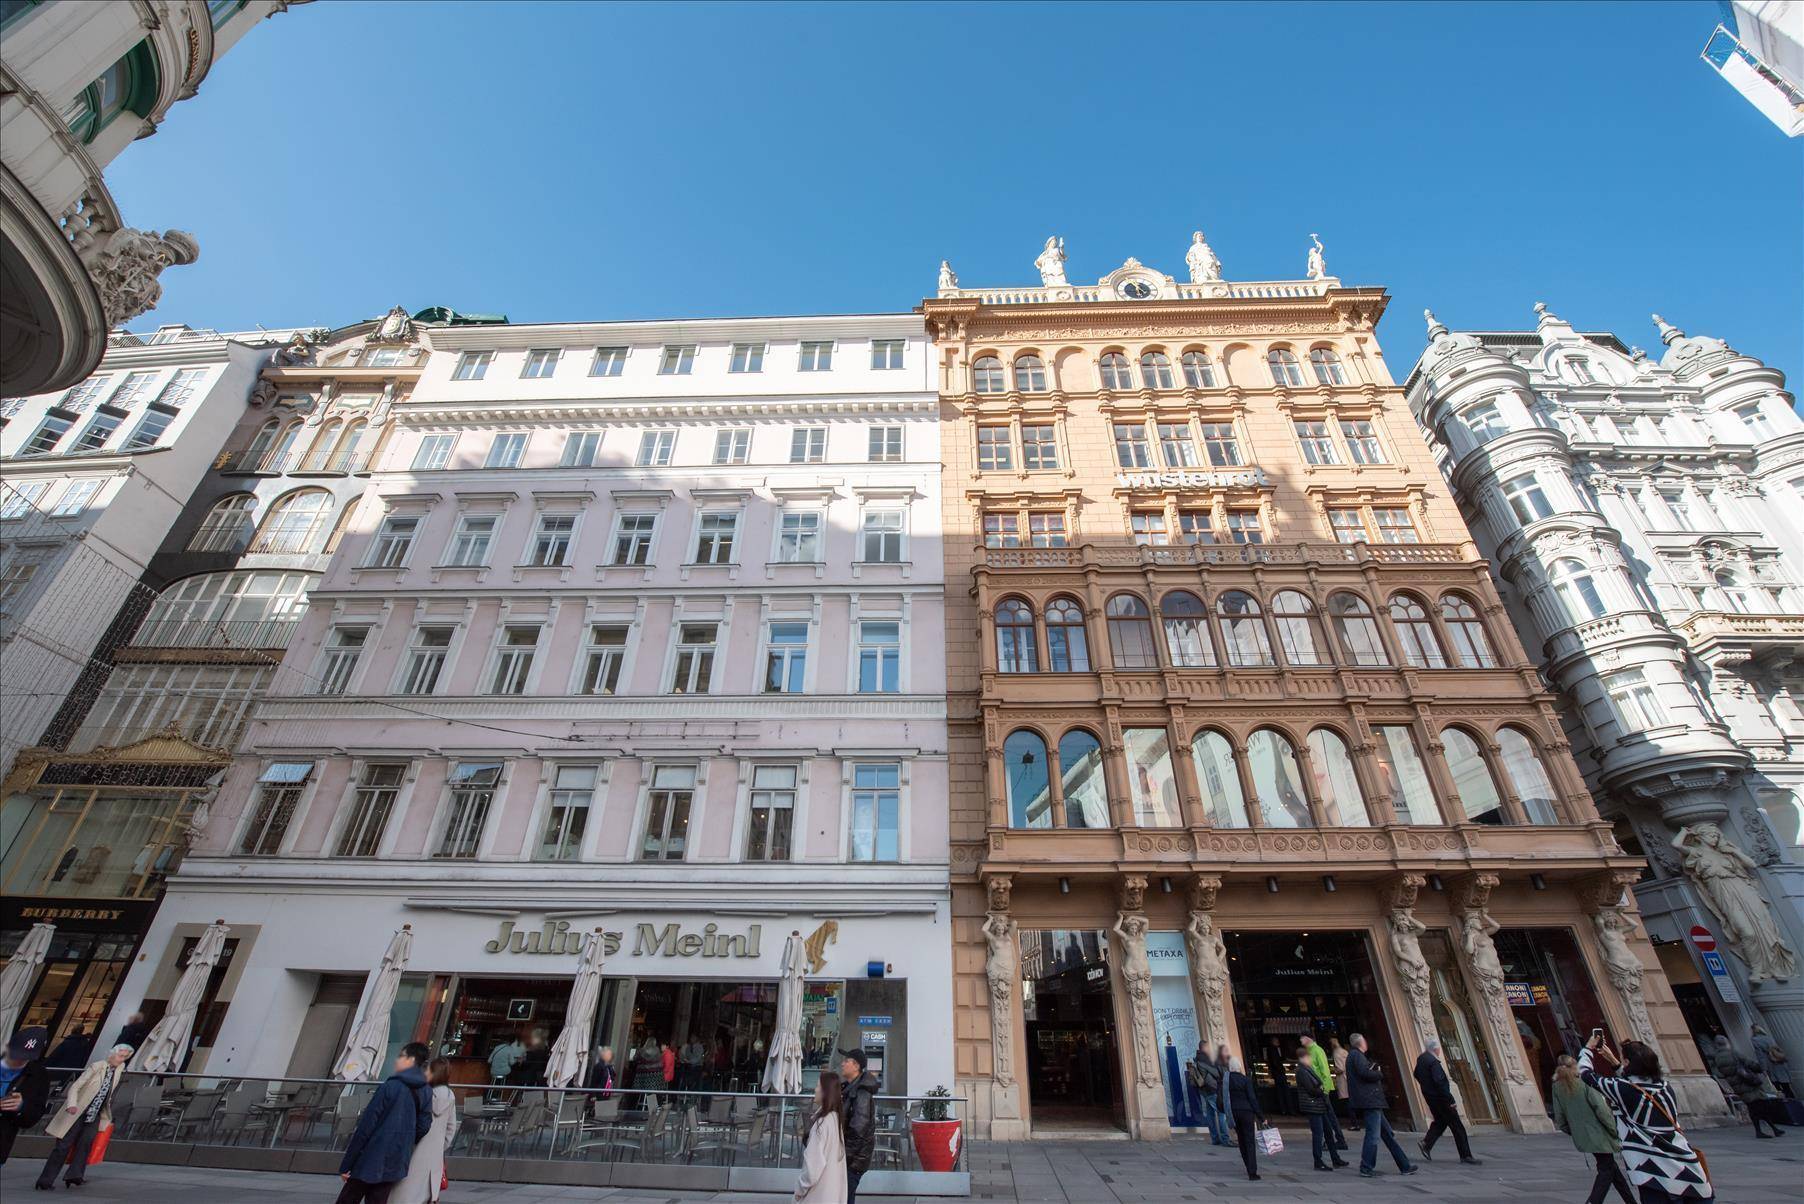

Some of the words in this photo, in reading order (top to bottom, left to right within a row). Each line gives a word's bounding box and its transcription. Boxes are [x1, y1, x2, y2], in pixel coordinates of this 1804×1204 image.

[19, 906, 125, 920] BURBERRY
[486, 920, 623, 956] Julius
[632, 922, 762, 958] Meinl
[1145, 950, 1184, 958] METAXA
[1274, 968, 1305, 976] Julius
[1307, 968, 1335, 976] Meinl
